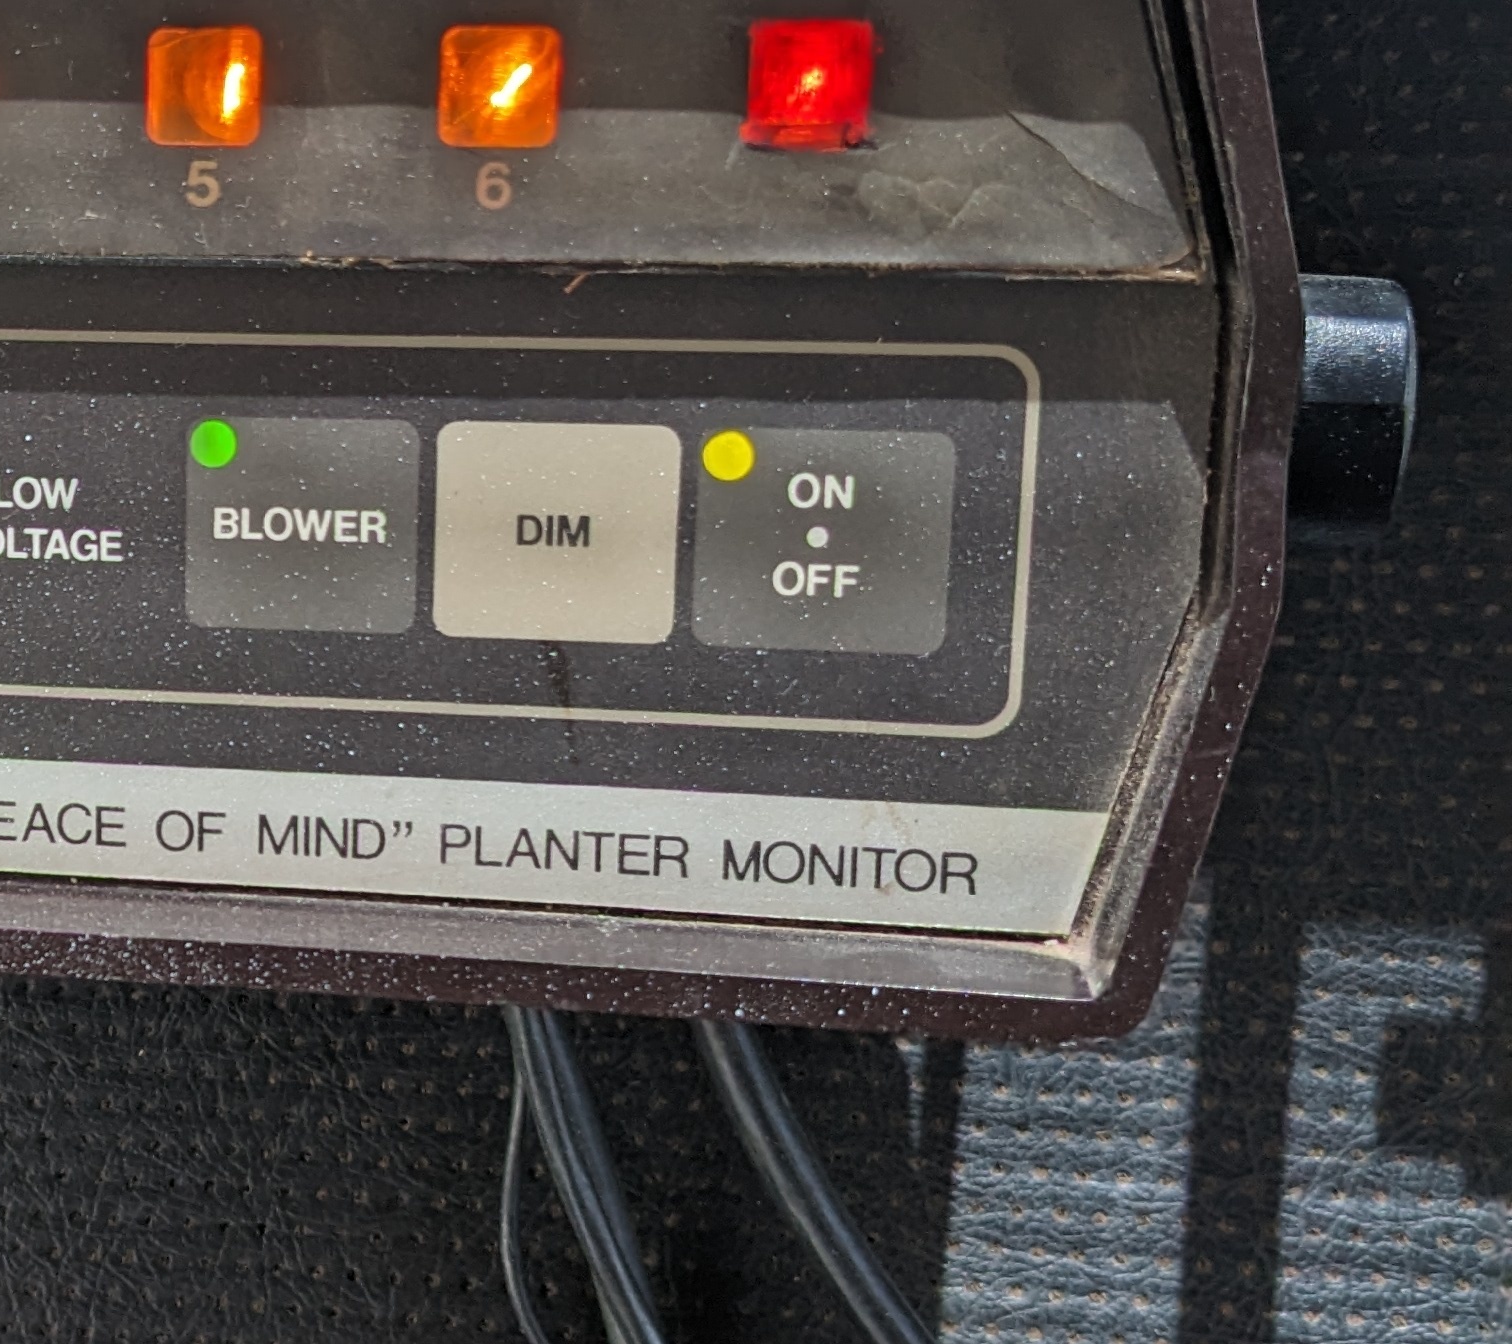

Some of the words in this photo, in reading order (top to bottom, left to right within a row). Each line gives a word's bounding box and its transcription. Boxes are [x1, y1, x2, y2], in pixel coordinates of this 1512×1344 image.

[188, 161, 221, 208] 5
[475, 162, 513, 210] 6
[788, 472, 855, 510] ON
[212, 506, 388, 544] BLOWER
[515, 514, 592, 547] DIM
[771, 561, 860, 598] OFF
[155, 809, 227, 852] OF
[439, 823, 690, 880] PLANTER
[721, 838, 978, 896] MONITOR
